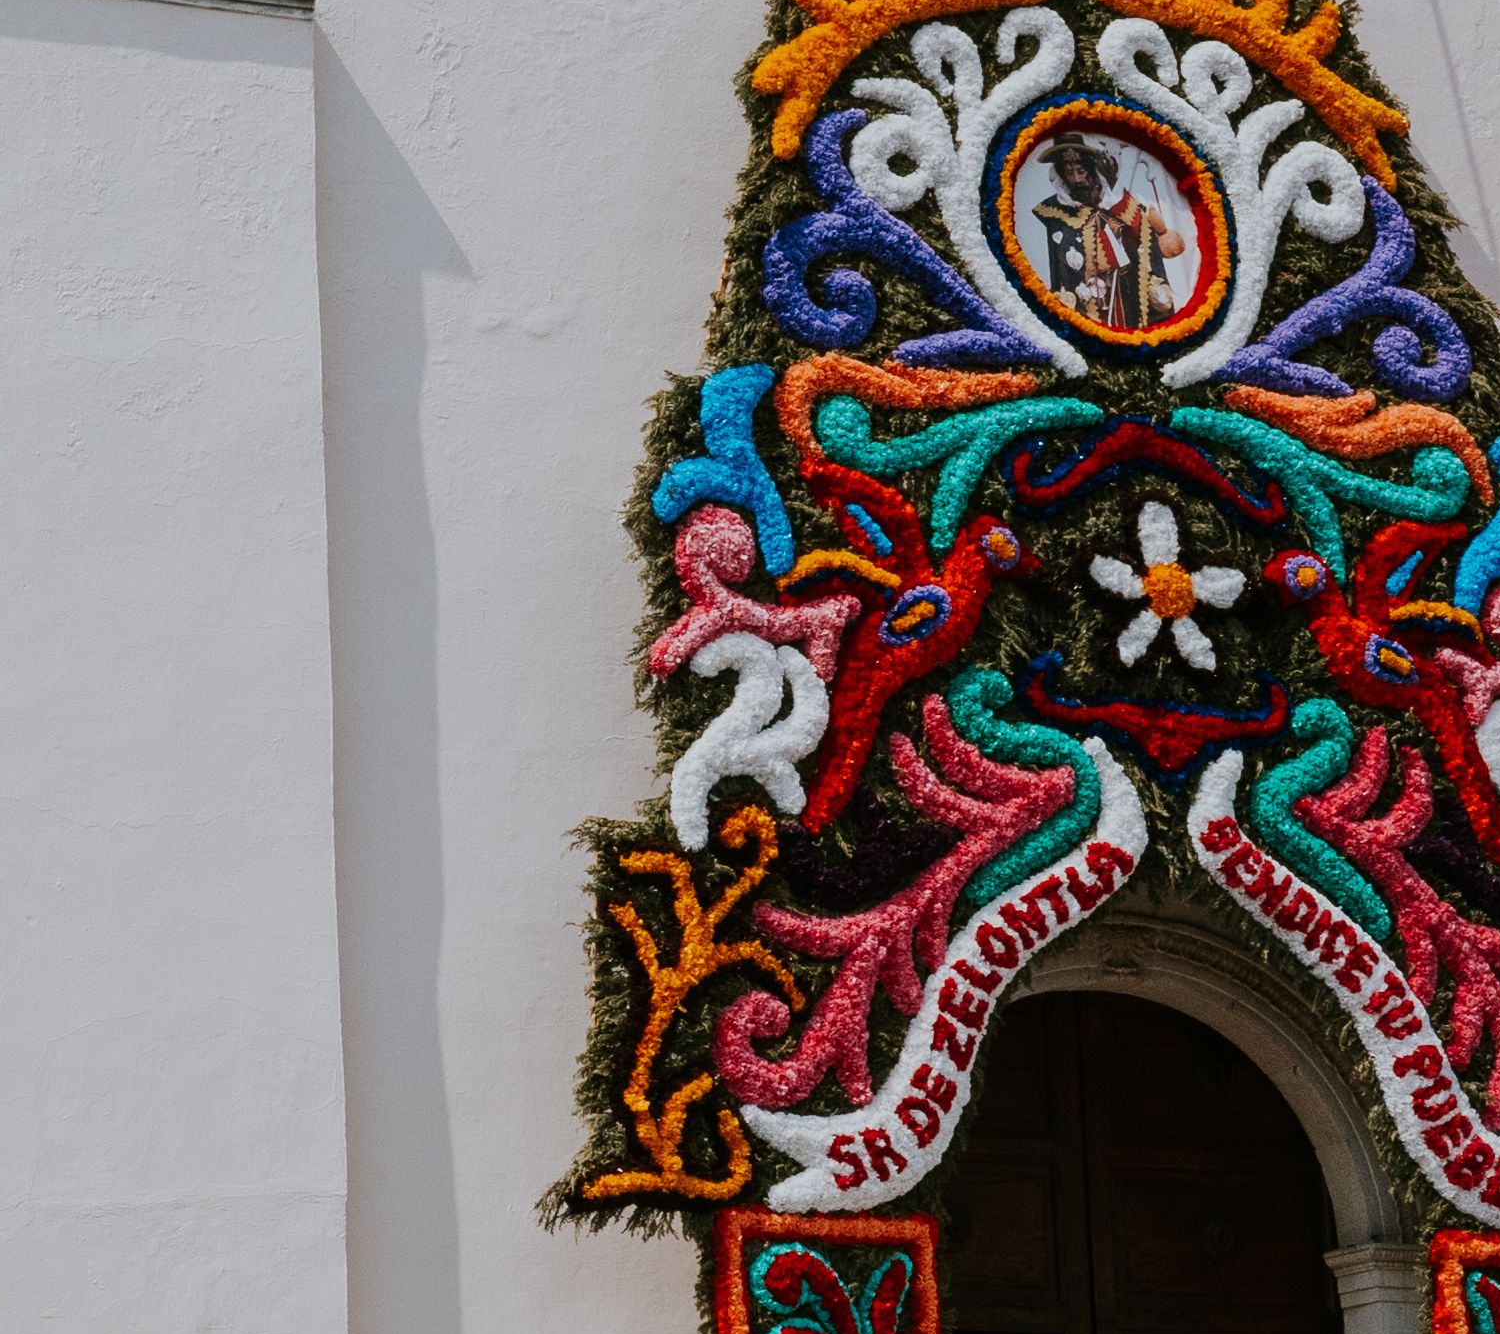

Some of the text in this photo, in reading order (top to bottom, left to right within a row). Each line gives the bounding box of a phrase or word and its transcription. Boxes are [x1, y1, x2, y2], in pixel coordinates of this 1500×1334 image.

[826, 841, 1135, 1191] SR DE ZELONTLA
[1201, 816, 1380, 994] BENDICE
[1363, 970, 1423, 1040] TU
